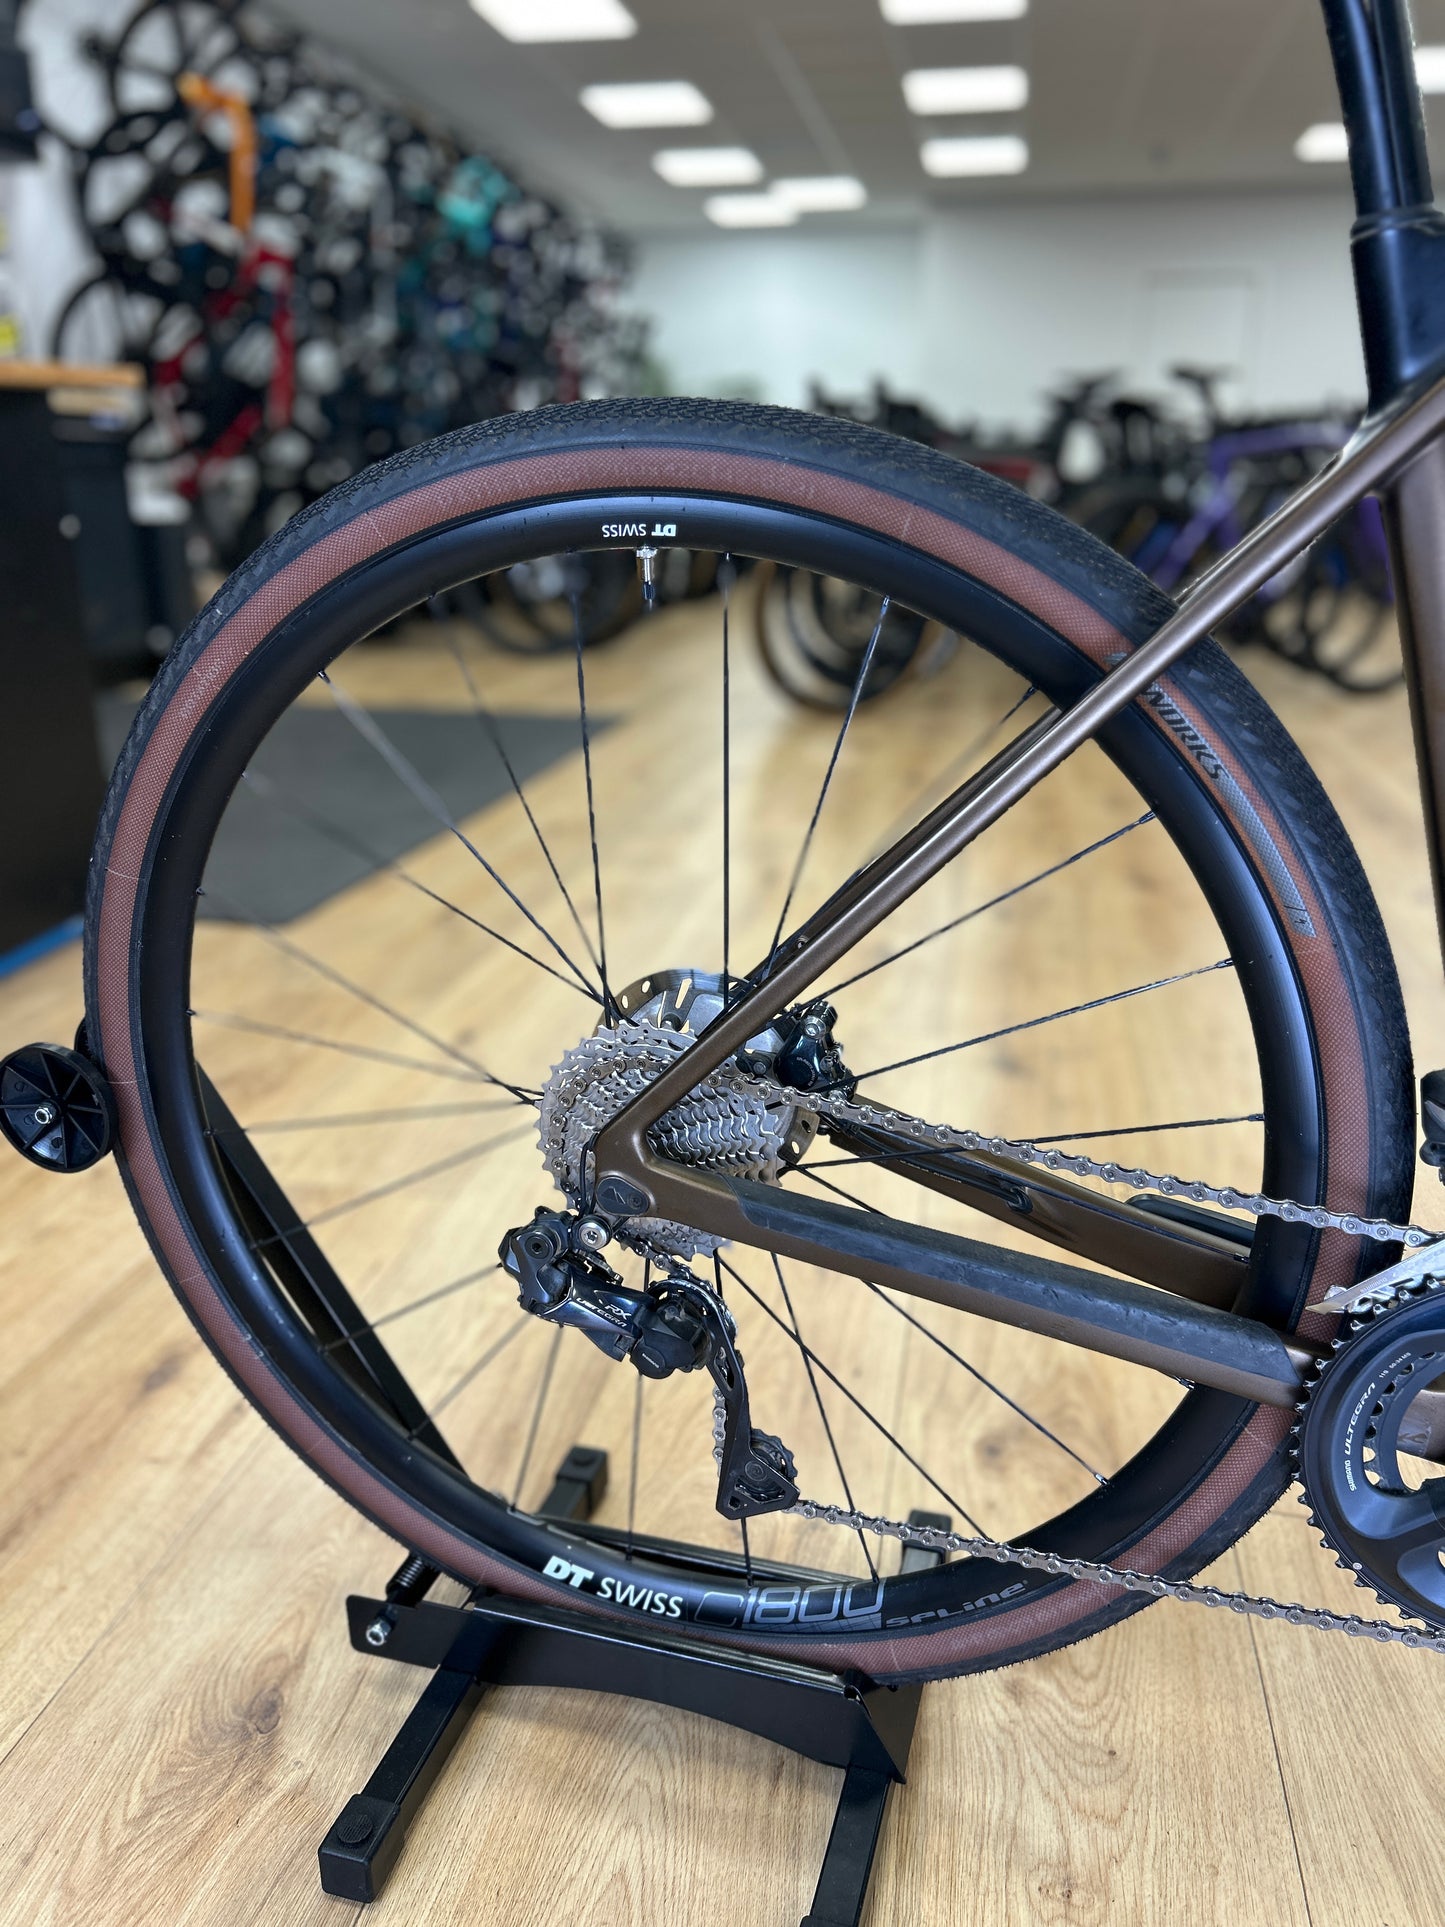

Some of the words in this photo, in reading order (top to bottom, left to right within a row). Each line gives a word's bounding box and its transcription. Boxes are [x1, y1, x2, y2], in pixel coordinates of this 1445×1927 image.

[601, 523, 647, 538] SWISS
[651, 523, 677, 537] DT
[604, 1303, 632, 1321] RX
[1344, 1382, 1376, 1456] ULTEGRA
[1343, 1460, 1357, 1492] SHIMANO
[542, 1555, 595, 1589] DT
[596, 1576, 684, 1618] SWISS
